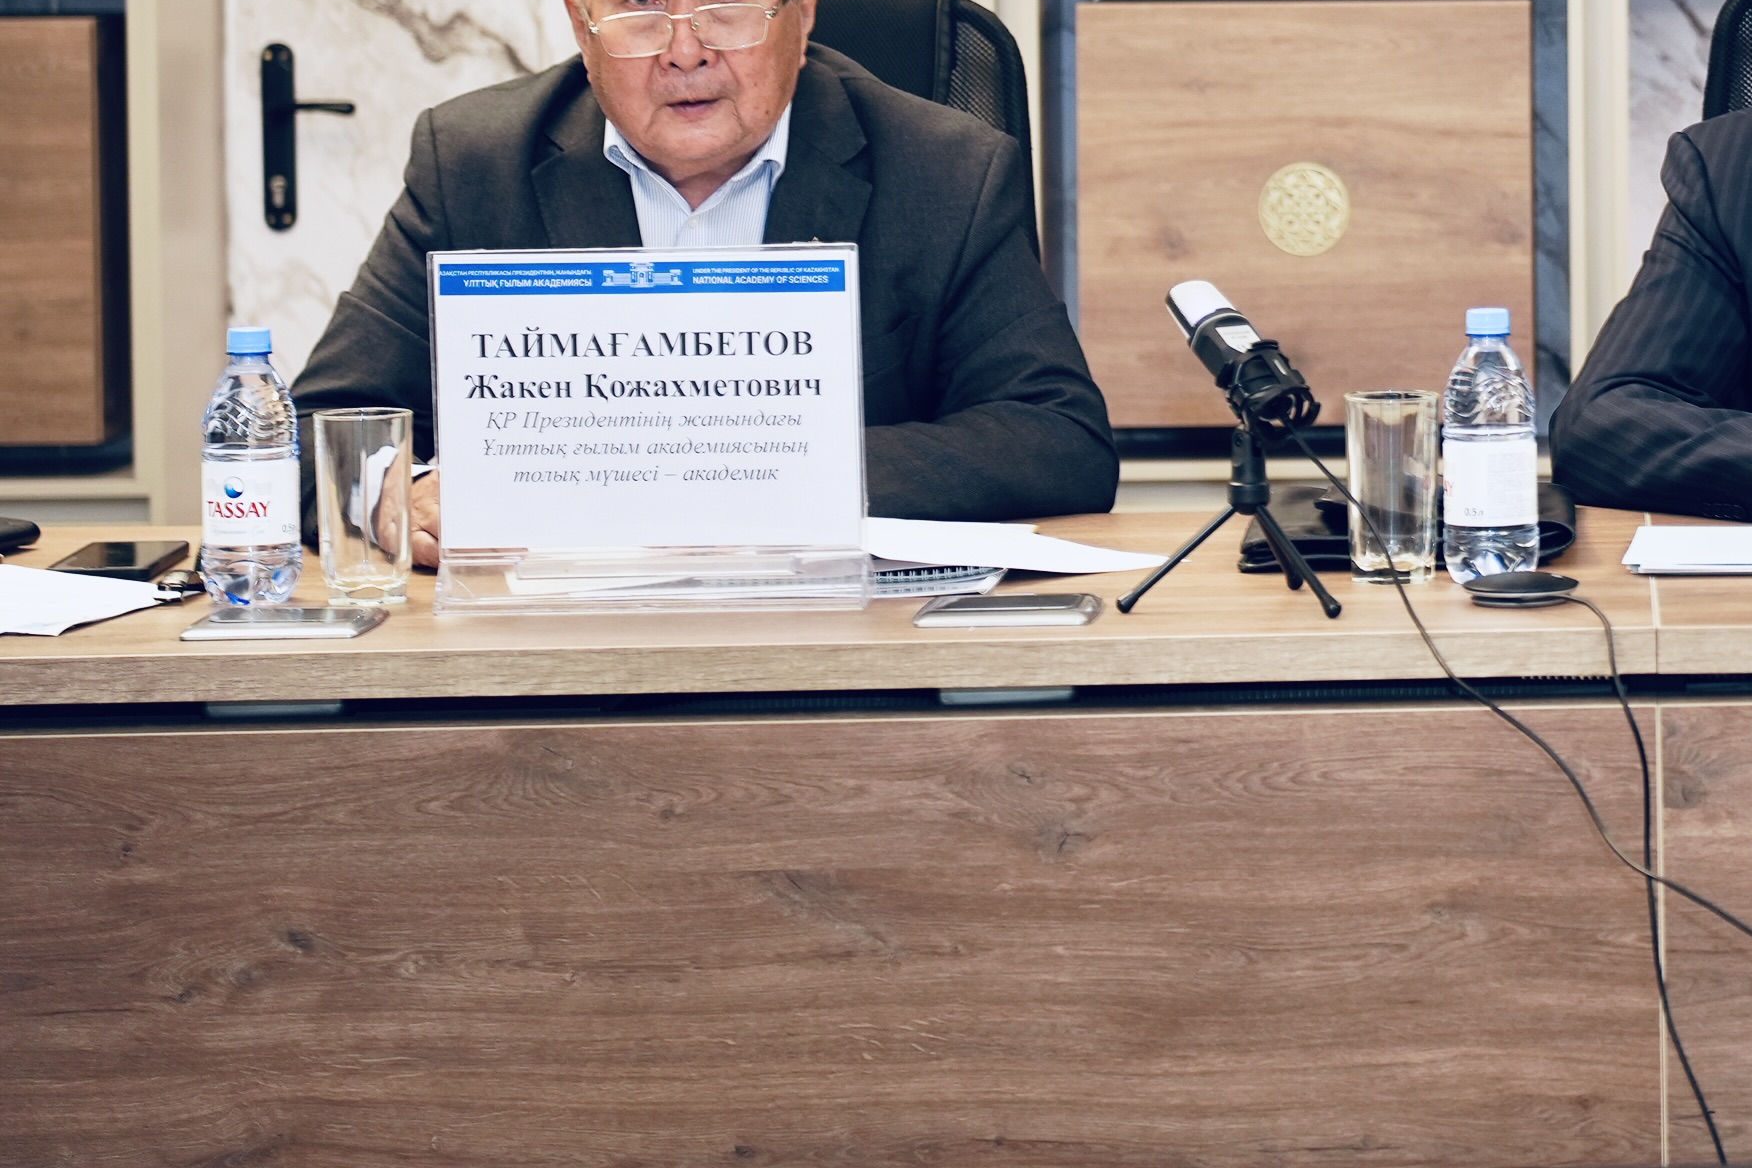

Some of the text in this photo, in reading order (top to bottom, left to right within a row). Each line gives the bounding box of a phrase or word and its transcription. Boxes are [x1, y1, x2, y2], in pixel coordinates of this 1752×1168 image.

[533, 278, 592, 288] АКАДЕМИЯСЫ
[692, 274, 829, 284] NATIONAL ACADEMY OF SCIENCES
[471, 326, 814, 359] ТАЙМАҒАМБЕТОВ
[464, 373, 822, 402] Жакен Қожахметович
[486, 409, 802, 433] ҚР Президентінің жанындағы
[482, 436, 808, 458] Ұлттық ғылым академиясының
[513, 470, 581, 486] толық
[585, 465, 660, 486] мүшесі
[682, 464, 779, 481] академик
[207, 500, 270, 518] TASSAY
